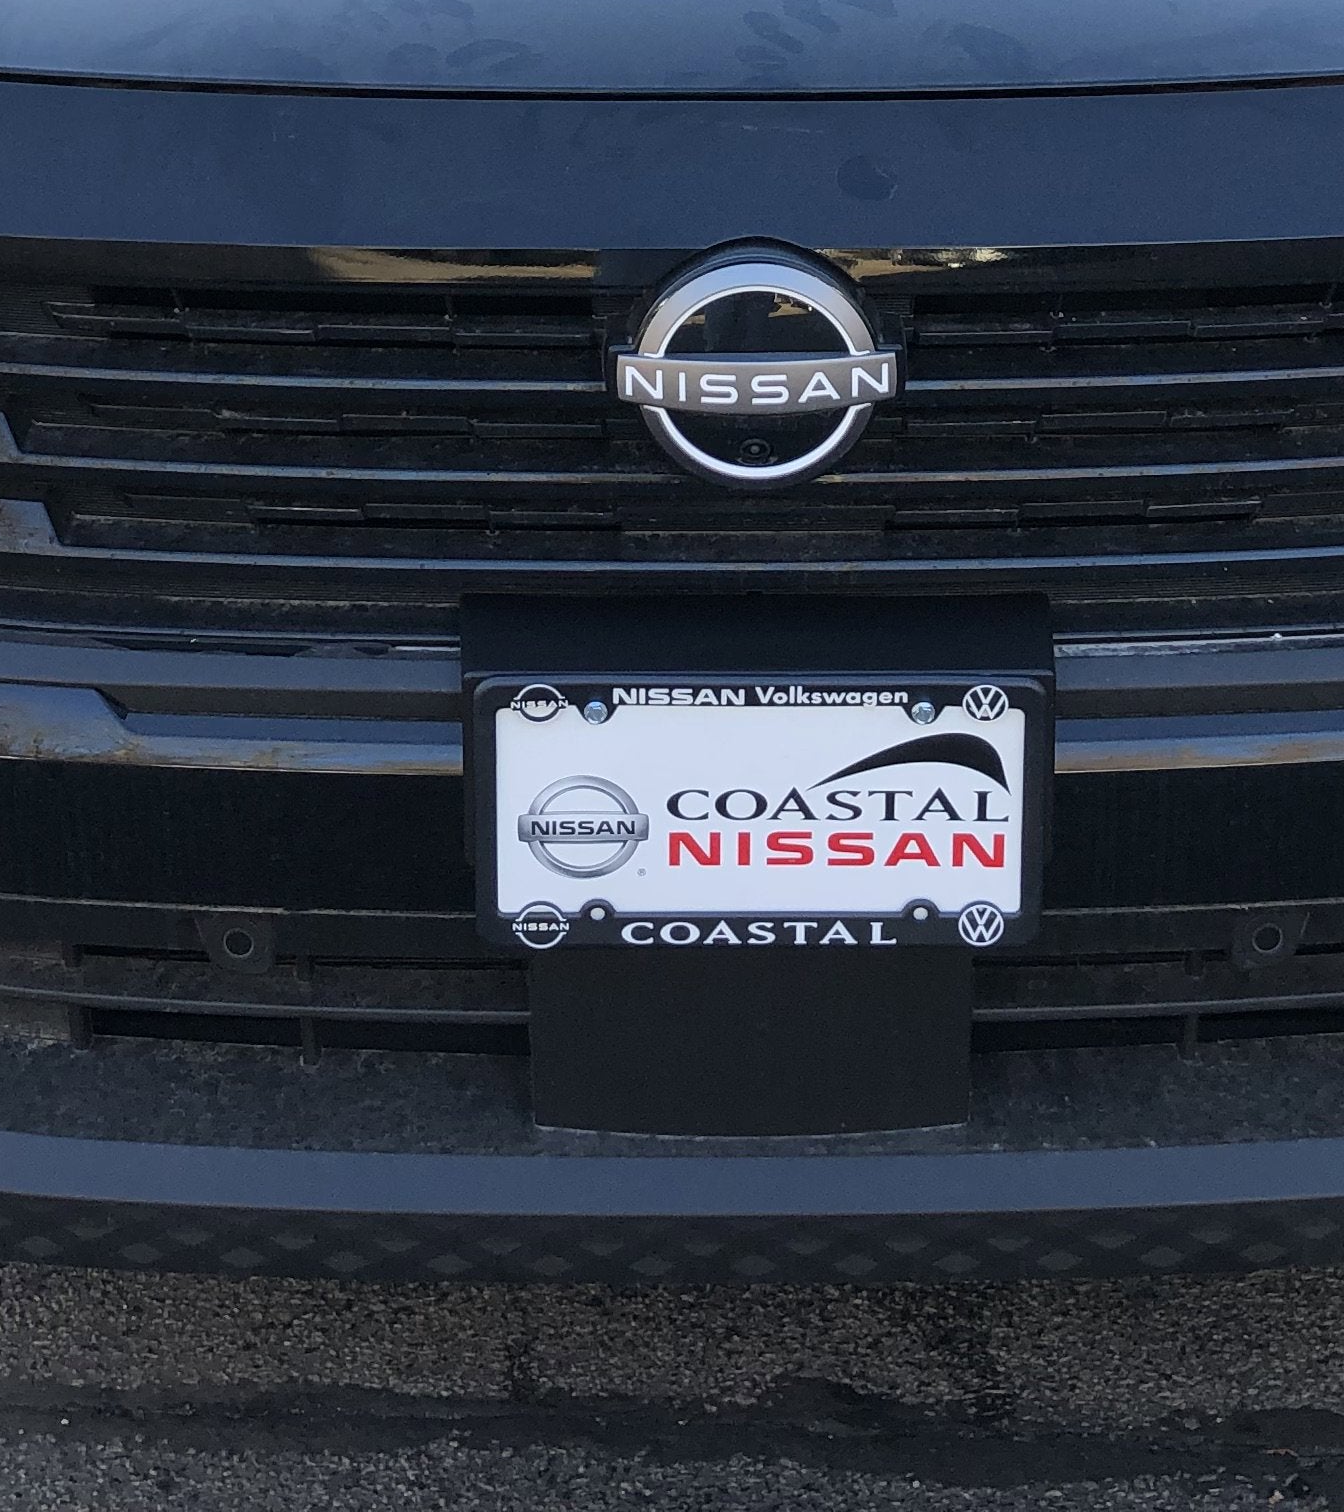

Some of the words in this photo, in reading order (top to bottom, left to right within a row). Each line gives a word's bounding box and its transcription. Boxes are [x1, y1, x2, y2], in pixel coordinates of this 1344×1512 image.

[623, 362, 890, 406] NISSAN
[510, 699, 569, 709] NISSAN
[612, 687, 745, 707] NISSAN
[755, 686, 909, 707] Volkswagen
[665, 788, 1010, 822] COASTAL
[530, 819, 636, 837] NISSAN
[668, 831, 1006, 869] NISSAN
[512, 922, 570, 932] NISSAN
[620, 920, 897, 946] COASTAL
